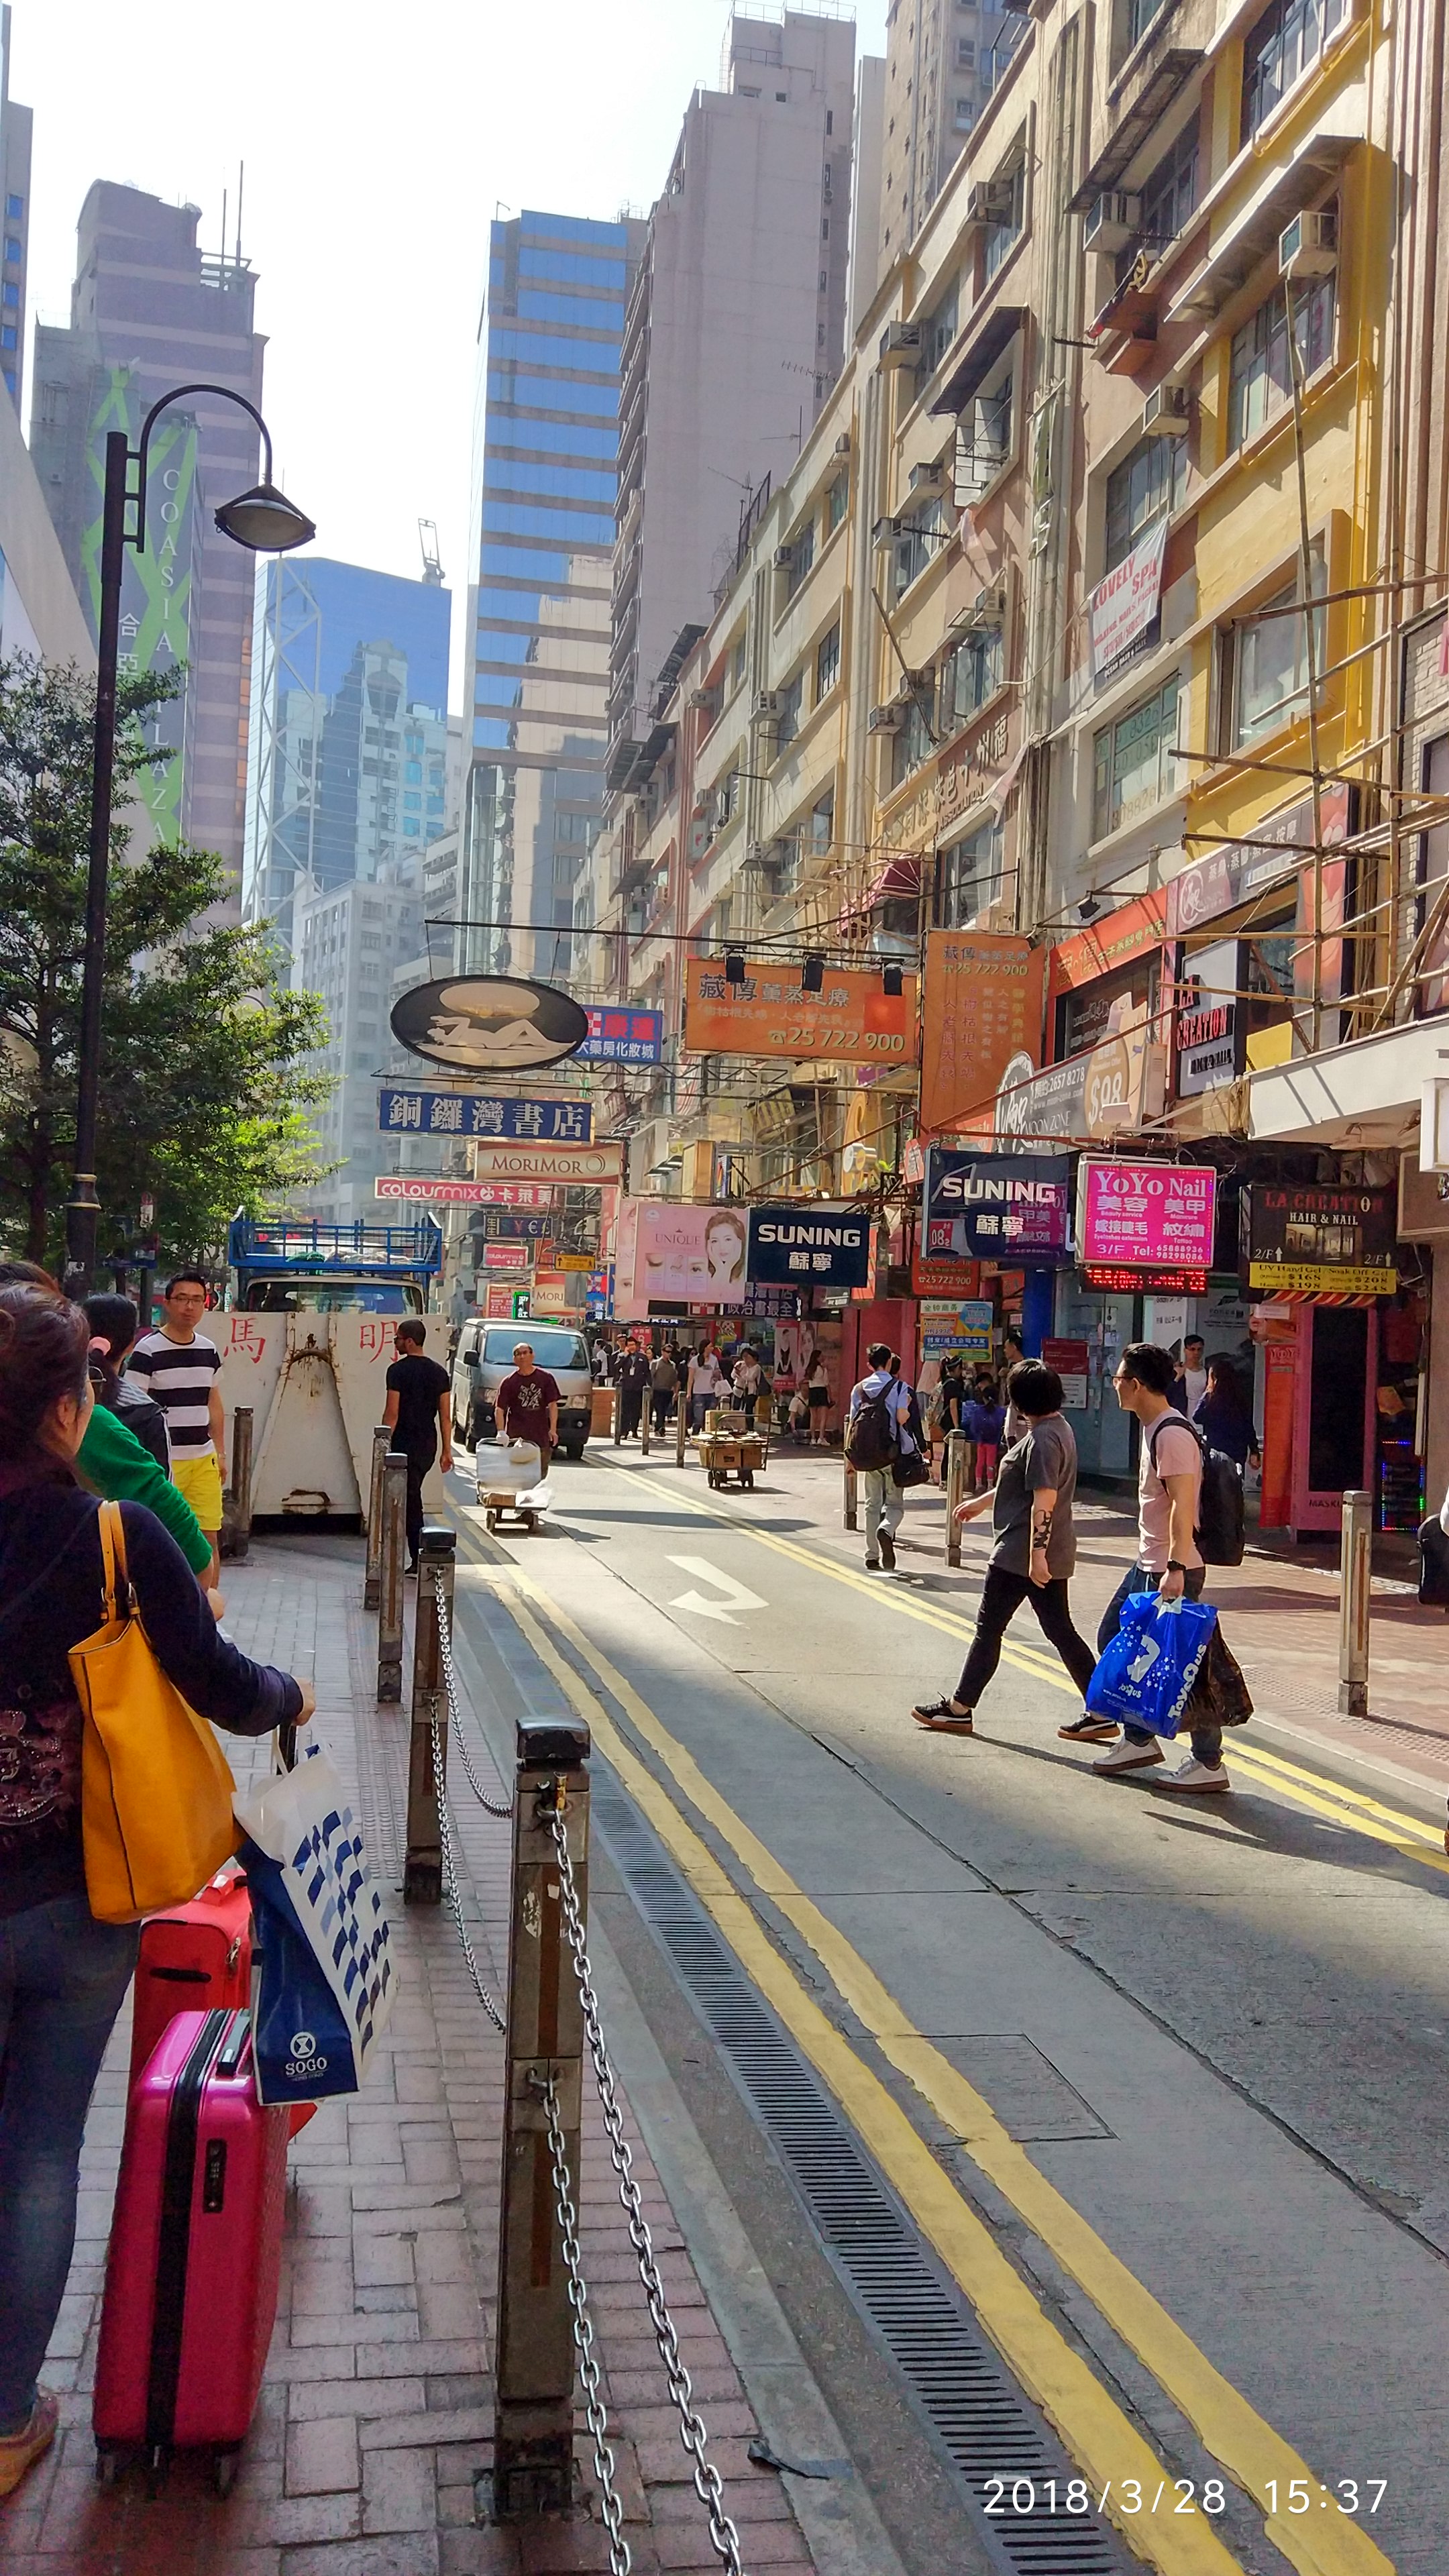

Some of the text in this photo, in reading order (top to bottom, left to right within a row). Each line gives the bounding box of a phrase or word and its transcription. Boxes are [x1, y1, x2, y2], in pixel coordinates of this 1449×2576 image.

[154, 468, 180, 653] COASIA
[1093, 555, 1136, 611] LOVELY
[1132, 558, 1157, 596] SPA
[150, 699, 169, 843] LAZA
[1004, 965, 1029, 976] 900
[788, 1026, 905, 1052] 25 722 900
[1176, 1004, 1229, 1051] CREATION
[388, 1094, 584, 1138] 銅鑼灣書店
[1049, 1110, 1073, 1131] ZONE
[942, 1177, 1056, 1203] SUNING
[1095, 1170, 1207, 1197] YoYo Nail
[1096, 1195, 1206, 1215] 美容 美甲
[1264, 1191, 1288, 1208] LA
[1289, 1212, 1358, 1226] HAIR & NAIL
[655, 1233, 702, 1245] UNIQUE
[757, 1224, 861, 1248] SUNING
[1096, 1244, 1203, 1256] 3/F Tel: 65888936
[1156, 1252, 1203, 1260] 98298086
[1254, 1248, 1274, 1260] 2/F
[938, 1276, 954, 1284] 722
[955, 1277, 971, 1285] 900
[223, 1318, 266, 1364] 馬
[360, 1321, 399, 1363] 明
[285, 2057, 327, 2076] SOGO
